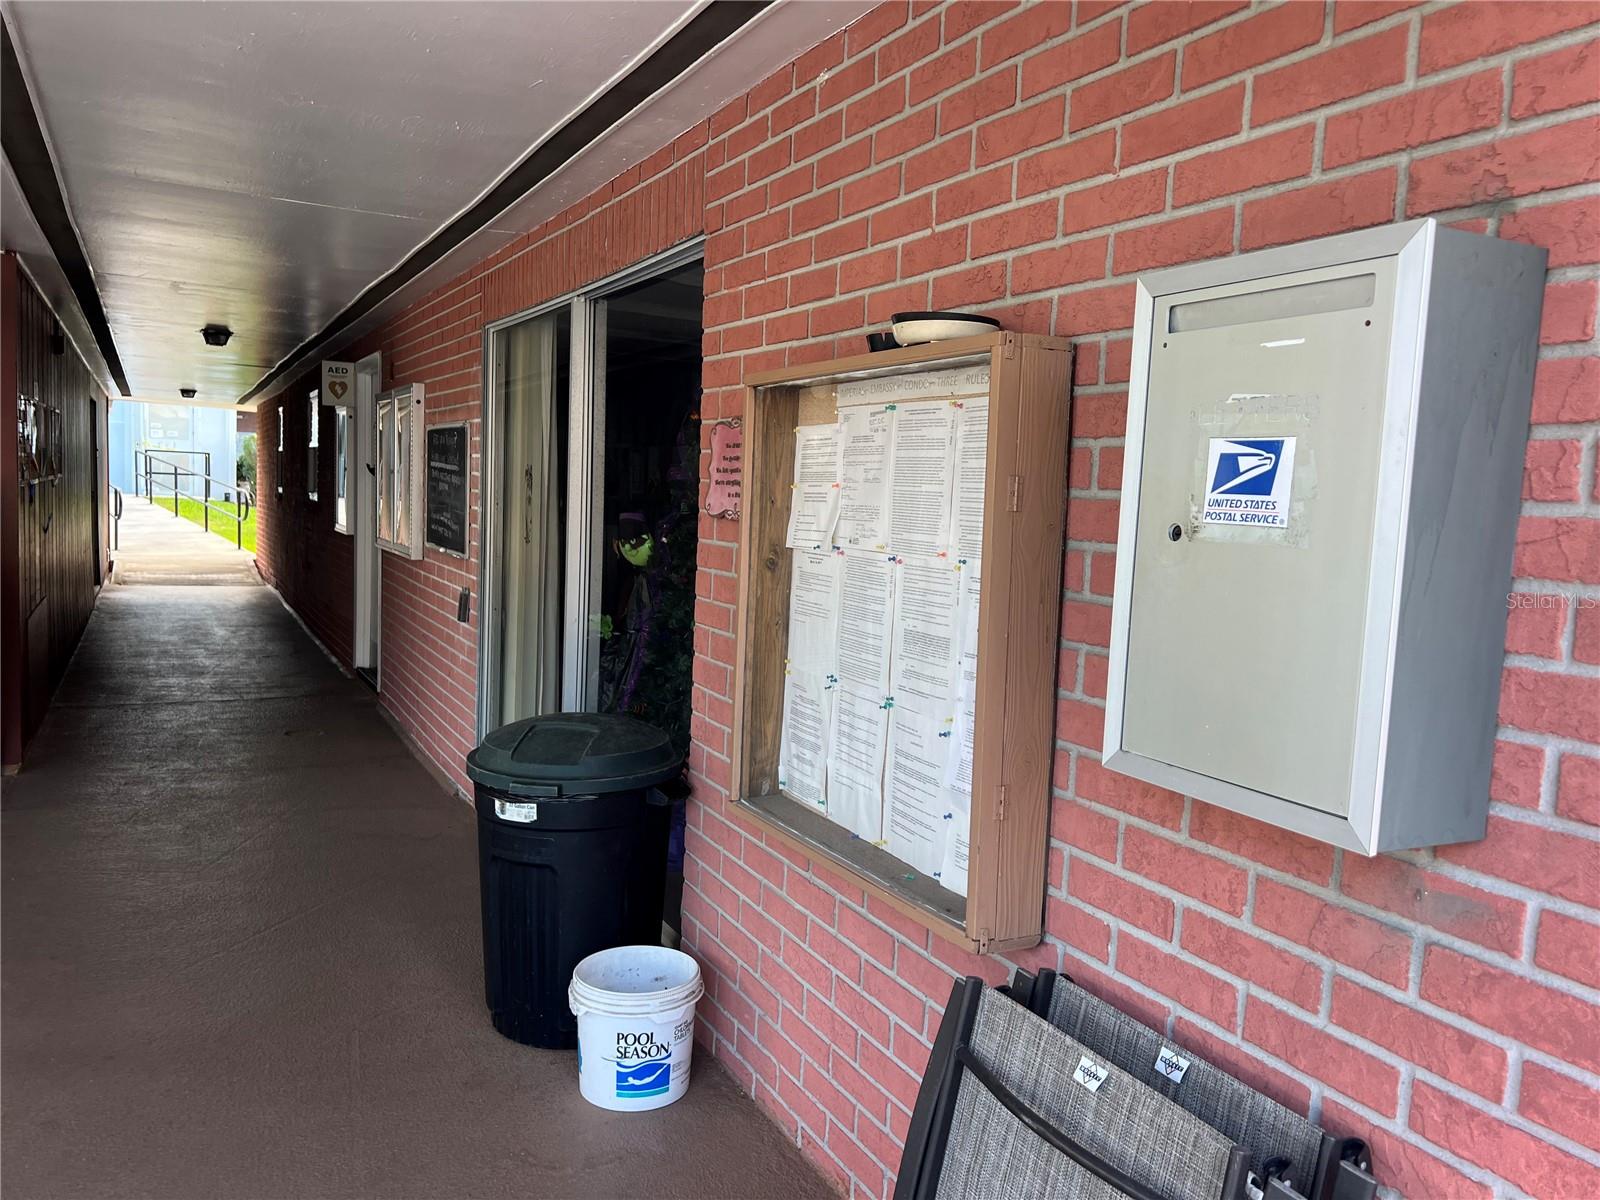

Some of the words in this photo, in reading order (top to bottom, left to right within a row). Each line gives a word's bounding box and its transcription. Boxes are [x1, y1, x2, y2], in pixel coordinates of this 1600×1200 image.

[328, 366, 348, 374] AED
[937, 375, 958, 387] THREE
[1207, 498, 1243, 509] UNITED
[1243, 499, 1276, 510] STATES
[1204, 511, 1238, 522] POSTAL
[1239, 513, 1278, 524] SERVICE
[616, 1032, 657, 1046] POOL
[616, 1041, 670, 1059] SEASON
